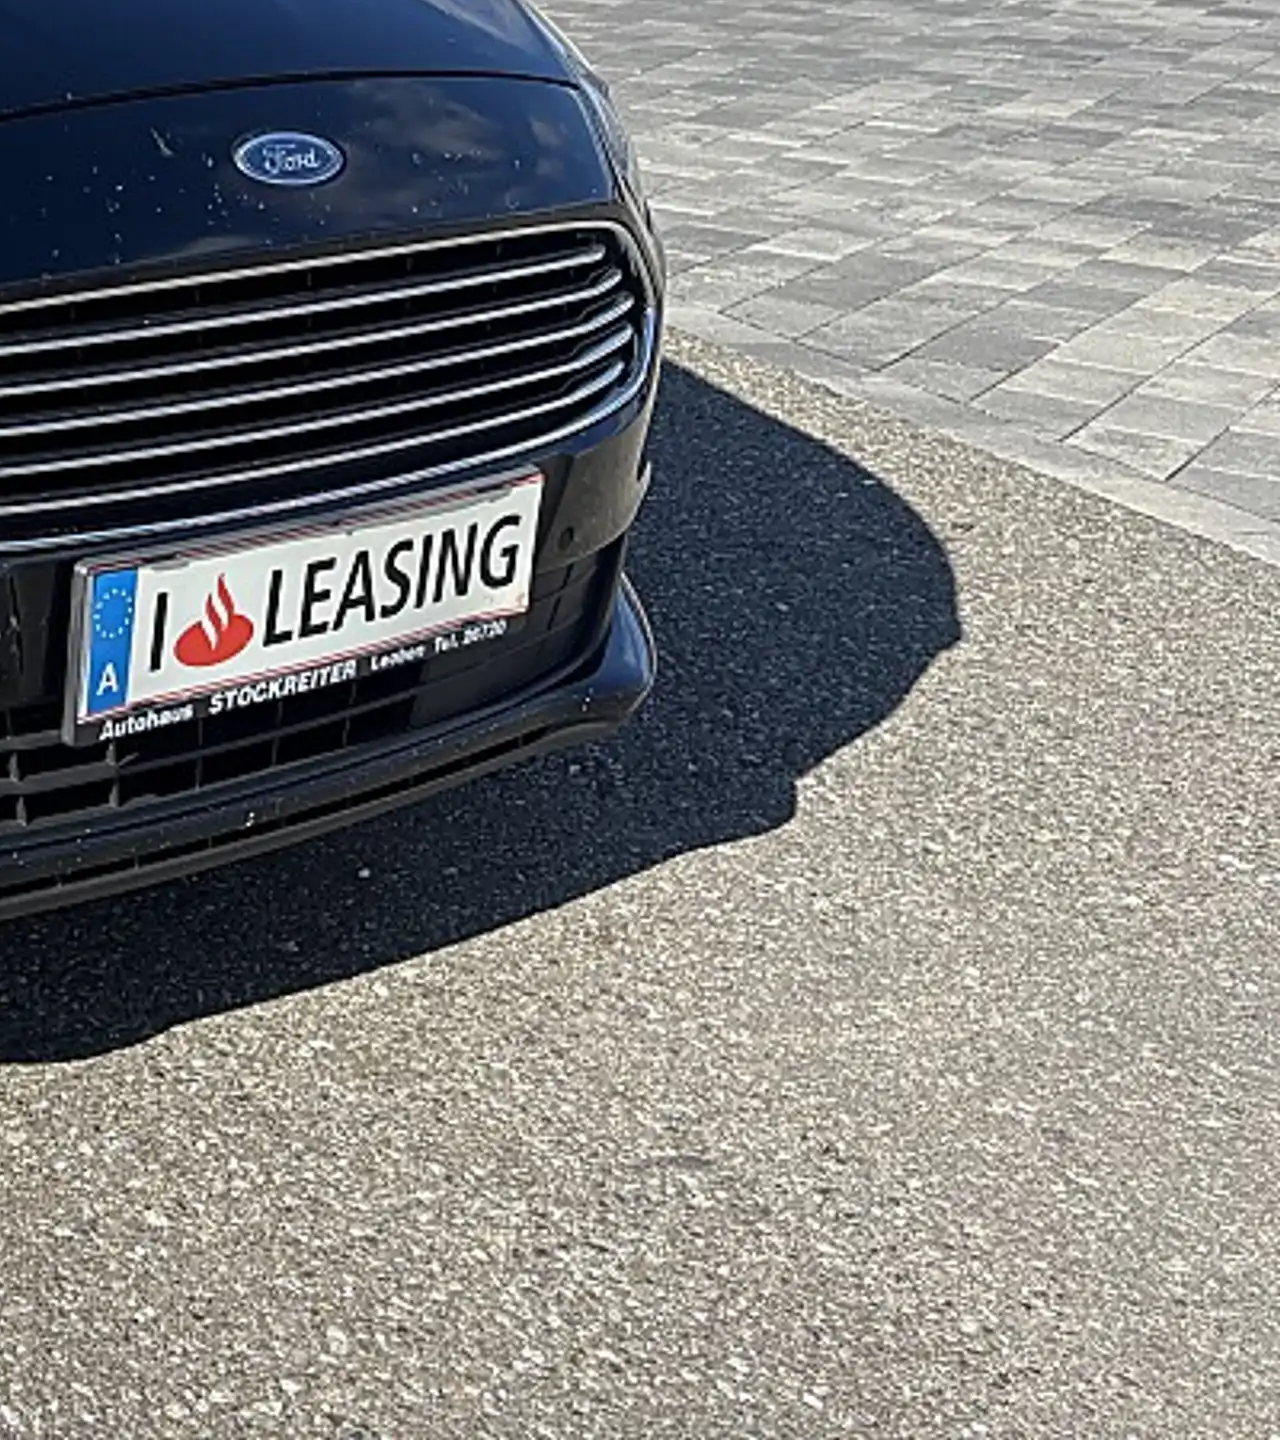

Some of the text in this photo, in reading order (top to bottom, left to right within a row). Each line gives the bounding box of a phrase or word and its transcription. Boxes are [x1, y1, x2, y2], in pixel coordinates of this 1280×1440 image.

[262, 144, 321, 174] Ford
[149, 514, 522, 672] I LEASING
[96, 662, 119, 696] A
[99, 703, 194, 741] Autohaus
[208, 659, 357, 715] STOCKREITER
